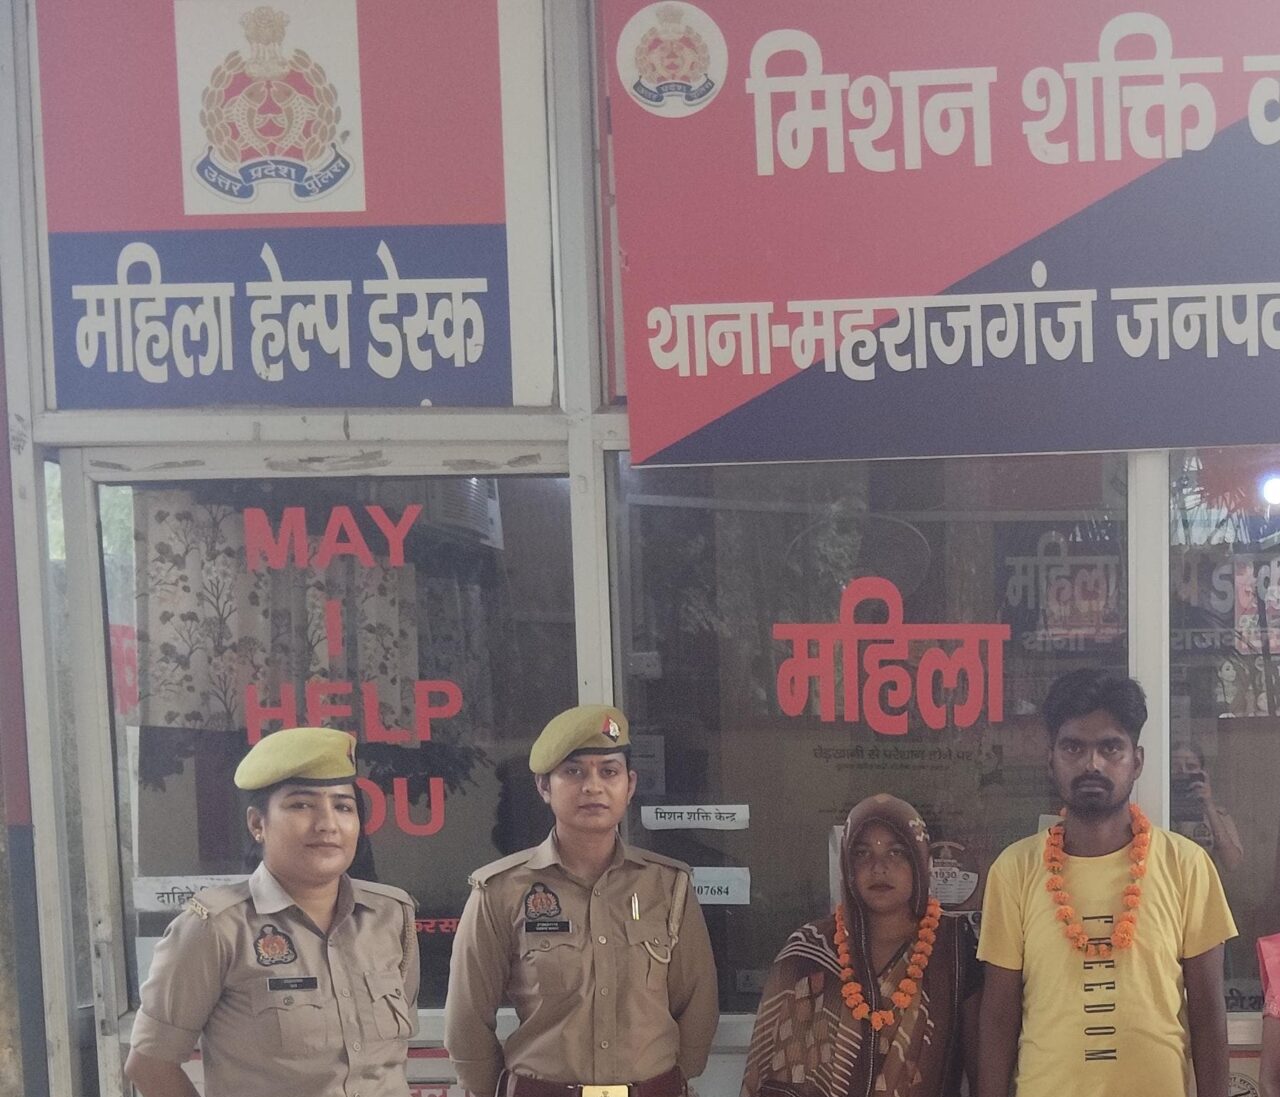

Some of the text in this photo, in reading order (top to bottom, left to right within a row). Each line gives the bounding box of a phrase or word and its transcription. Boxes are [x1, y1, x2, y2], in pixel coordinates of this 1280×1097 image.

[745, 29, 998, 176] मिशन
[1021, 12, 1223, 165] शक्ति
[203, 158, 346, 196] उत्तर प्रदेश पुलिस
[72, 240, 488, 383] महिला हेल्प डेस्क
[243, 503, 423, 571] MAY
[325, 600, 344, 656] I
[773, 576, 1011, 735] महिला
[245, 680, 463, 746] HELP
[655, 806, 737, 823] मिशन शक्ति केन्द्र
